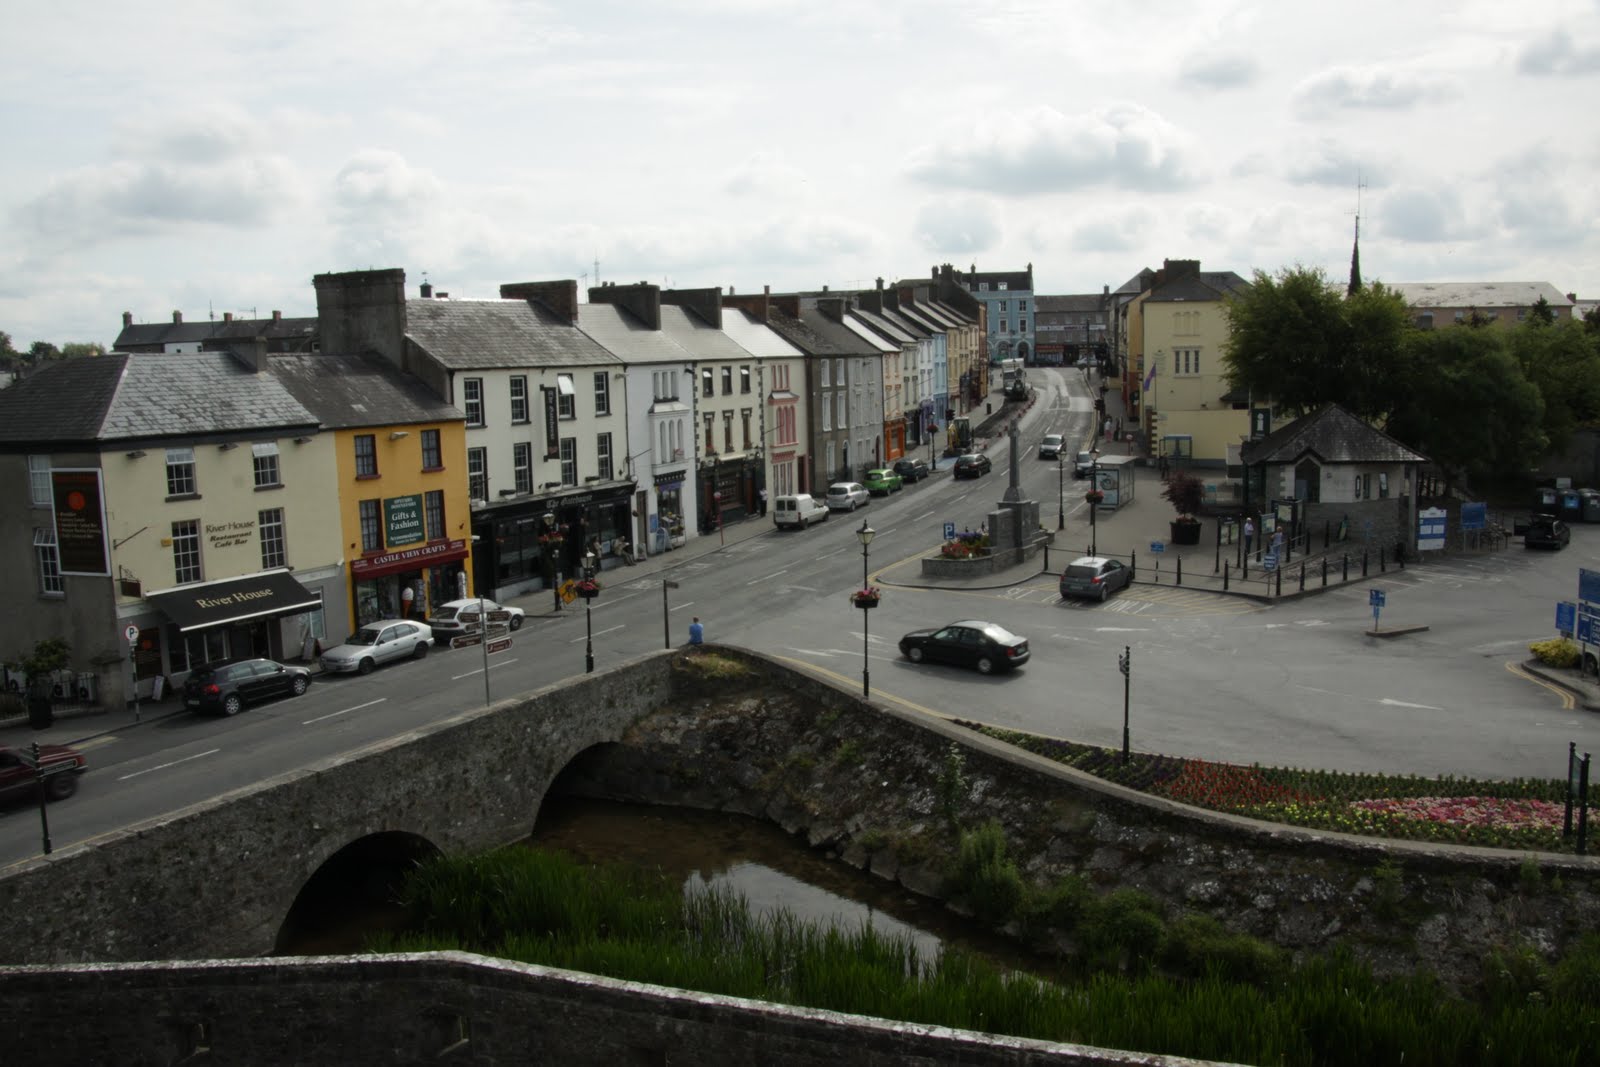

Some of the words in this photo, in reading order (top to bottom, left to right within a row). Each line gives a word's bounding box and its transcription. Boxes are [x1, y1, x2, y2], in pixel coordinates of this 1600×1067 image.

[392, 512, 410, 520] Gifts
[411, 510, 417, 518] &
[206, 524, 227, 533] River
[228, 521, 255, 529] House
[390, 520, 419, 530] Fashion
[945, 525, 953, 536] P
[210, 531, 252, 541] Restaurant
[374, 554, 401, 564] CASTLE
[401, 551, 420, 559] VIEW
[421, 544, 447, 555] CRAFTS
[196, 598, 233, 608] River
[232, 589, 274, 602] House
[129, 627, 135, 638] P
